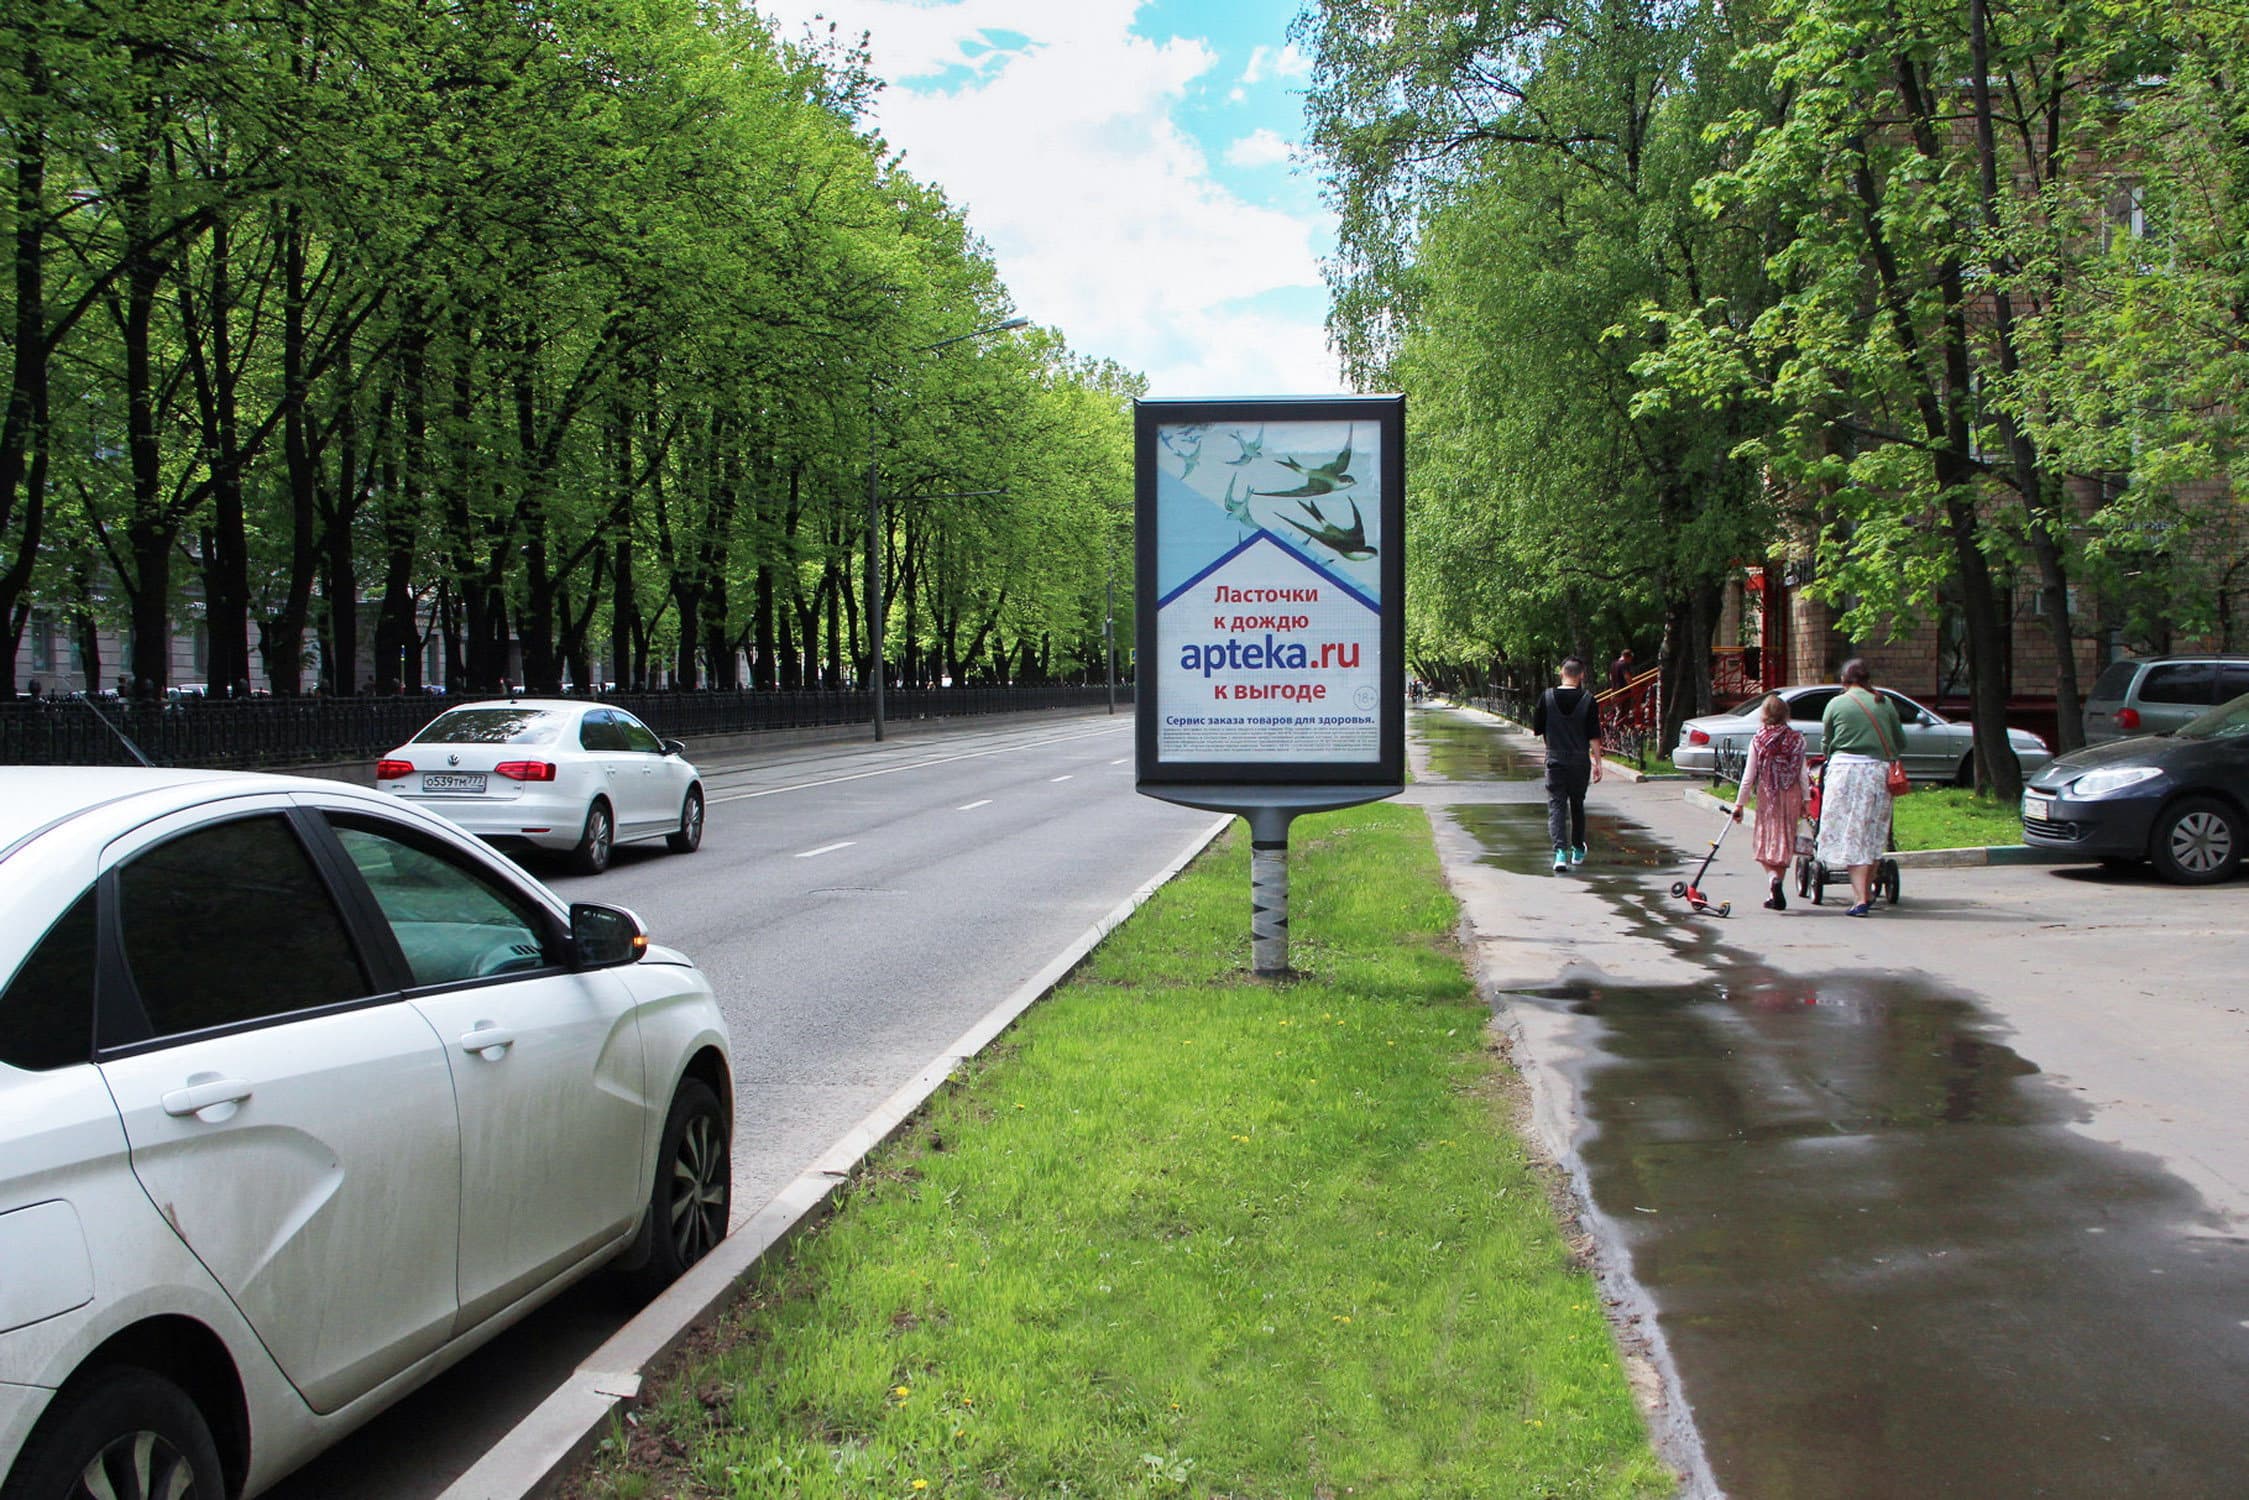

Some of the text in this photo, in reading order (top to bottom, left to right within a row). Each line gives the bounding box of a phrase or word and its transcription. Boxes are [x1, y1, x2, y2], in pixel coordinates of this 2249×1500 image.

[1214, 585, 1318, 603] Ласточки
[1214, 615, 1309, 632] к дождю
[1180, 634, 1359, 678] apteka.ru
[1214, 684, 1327, 702] к выгоде
[1166, 715, 1376, 727] Сервис заказа товаров для здоровья.
